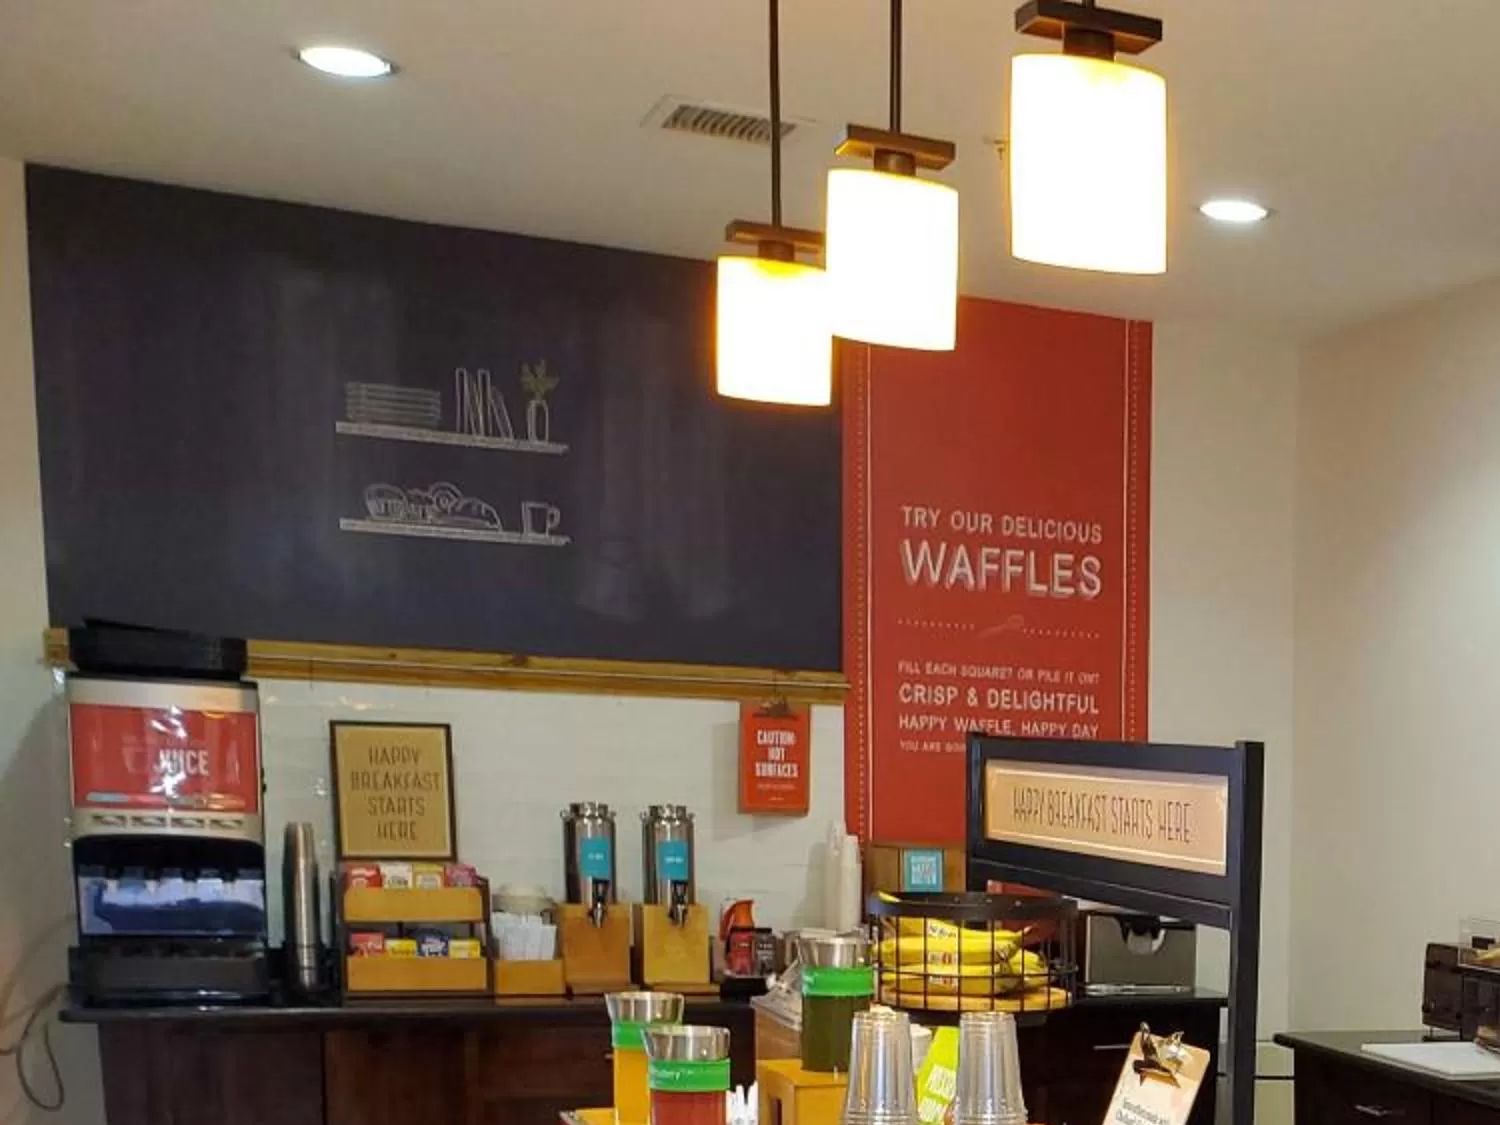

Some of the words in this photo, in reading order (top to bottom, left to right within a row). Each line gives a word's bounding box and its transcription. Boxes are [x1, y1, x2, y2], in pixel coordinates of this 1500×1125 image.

[902, 506, 940, 528] TRY
[951, 510, 992, 532] OUR
[1002, 515, 1102, 544] DELICIOUS
[902, 538, 1102, 598] WAFFLES
[898, 660, 921, 674] FILL
[925, 661, 957, 676] EACH
[1017, 667, 1033, 679] OR
[1038, 669, 1061, 683] PILE
[1064, 670, 1073, 683] IT
[899, 682, 958, 705] CRISP
[967, 687, 978, 707] &
[987, 688, 1099, 714] DELIGHTFUL
[899, 714, 947, 731] HAPPY
[1021, 721, 1067, 738] HAPPY
[1072, 725, 1099, 740] DAY
[369, 745, 421, 766] HAPPY
[900, 741, 918, 753] YOU
[922, 742, 941, 753] ARE
[755, 761, 798, 778] SURFACES
[351, 771, 440, 792] BREAKFAST
[367, 796, 425, 816] STARTS
[1013, 788, 1045, 822] HAPPY
[1048, 789, 1107, 832] BREAKFAST
[1111, 796, 1152, 839] STARTS
[1159, 801, 1190, 843] HERE
[377, 820, 416, 840] HERE
